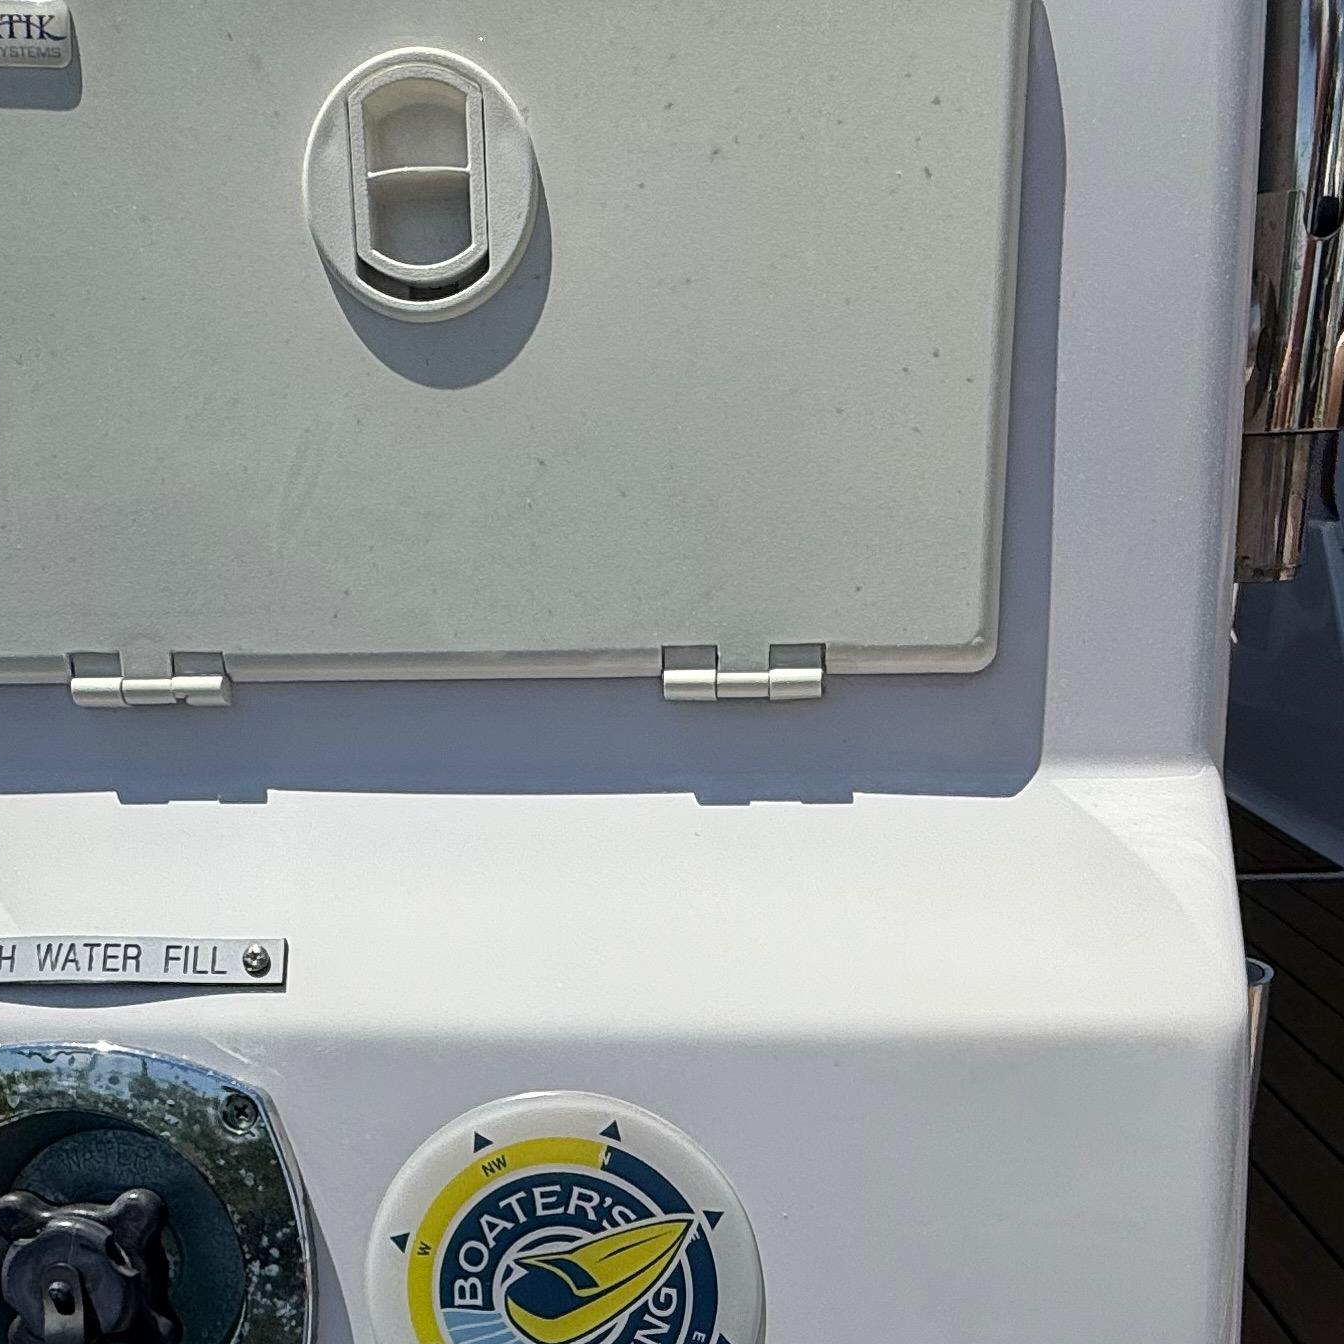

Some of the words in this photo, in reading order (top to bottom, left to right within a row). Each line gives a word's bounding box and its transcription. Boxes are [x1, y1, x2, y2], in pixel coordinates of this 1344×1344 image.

[37, 942, 141, 973] WATER
[164, 945, 228, 975] FILL
[481, 1154, 507, 1177] NW
[417, 1240, 432, 1257] W
